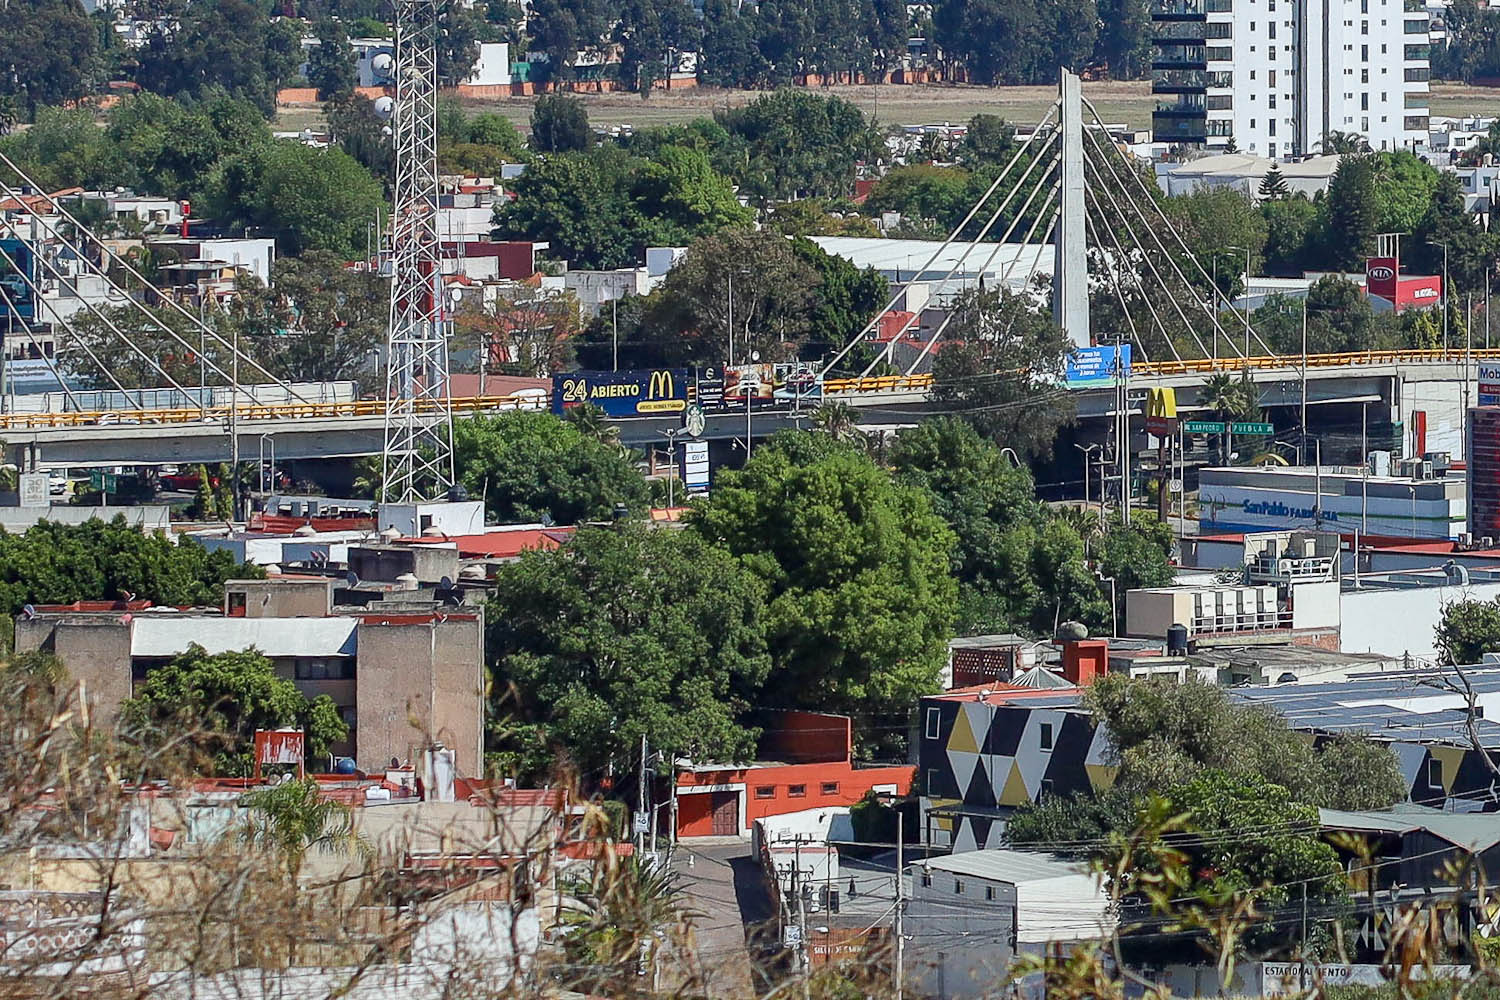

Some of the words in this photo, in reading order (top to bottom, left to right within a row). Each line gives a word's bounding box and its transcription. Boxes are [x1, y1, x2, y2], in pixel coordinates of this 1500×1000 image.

[562, 378, 588, 401] 24
[590, 384, 640, 399] ABIERTO
[1233, 424, 1263, 432] PUEBLA
